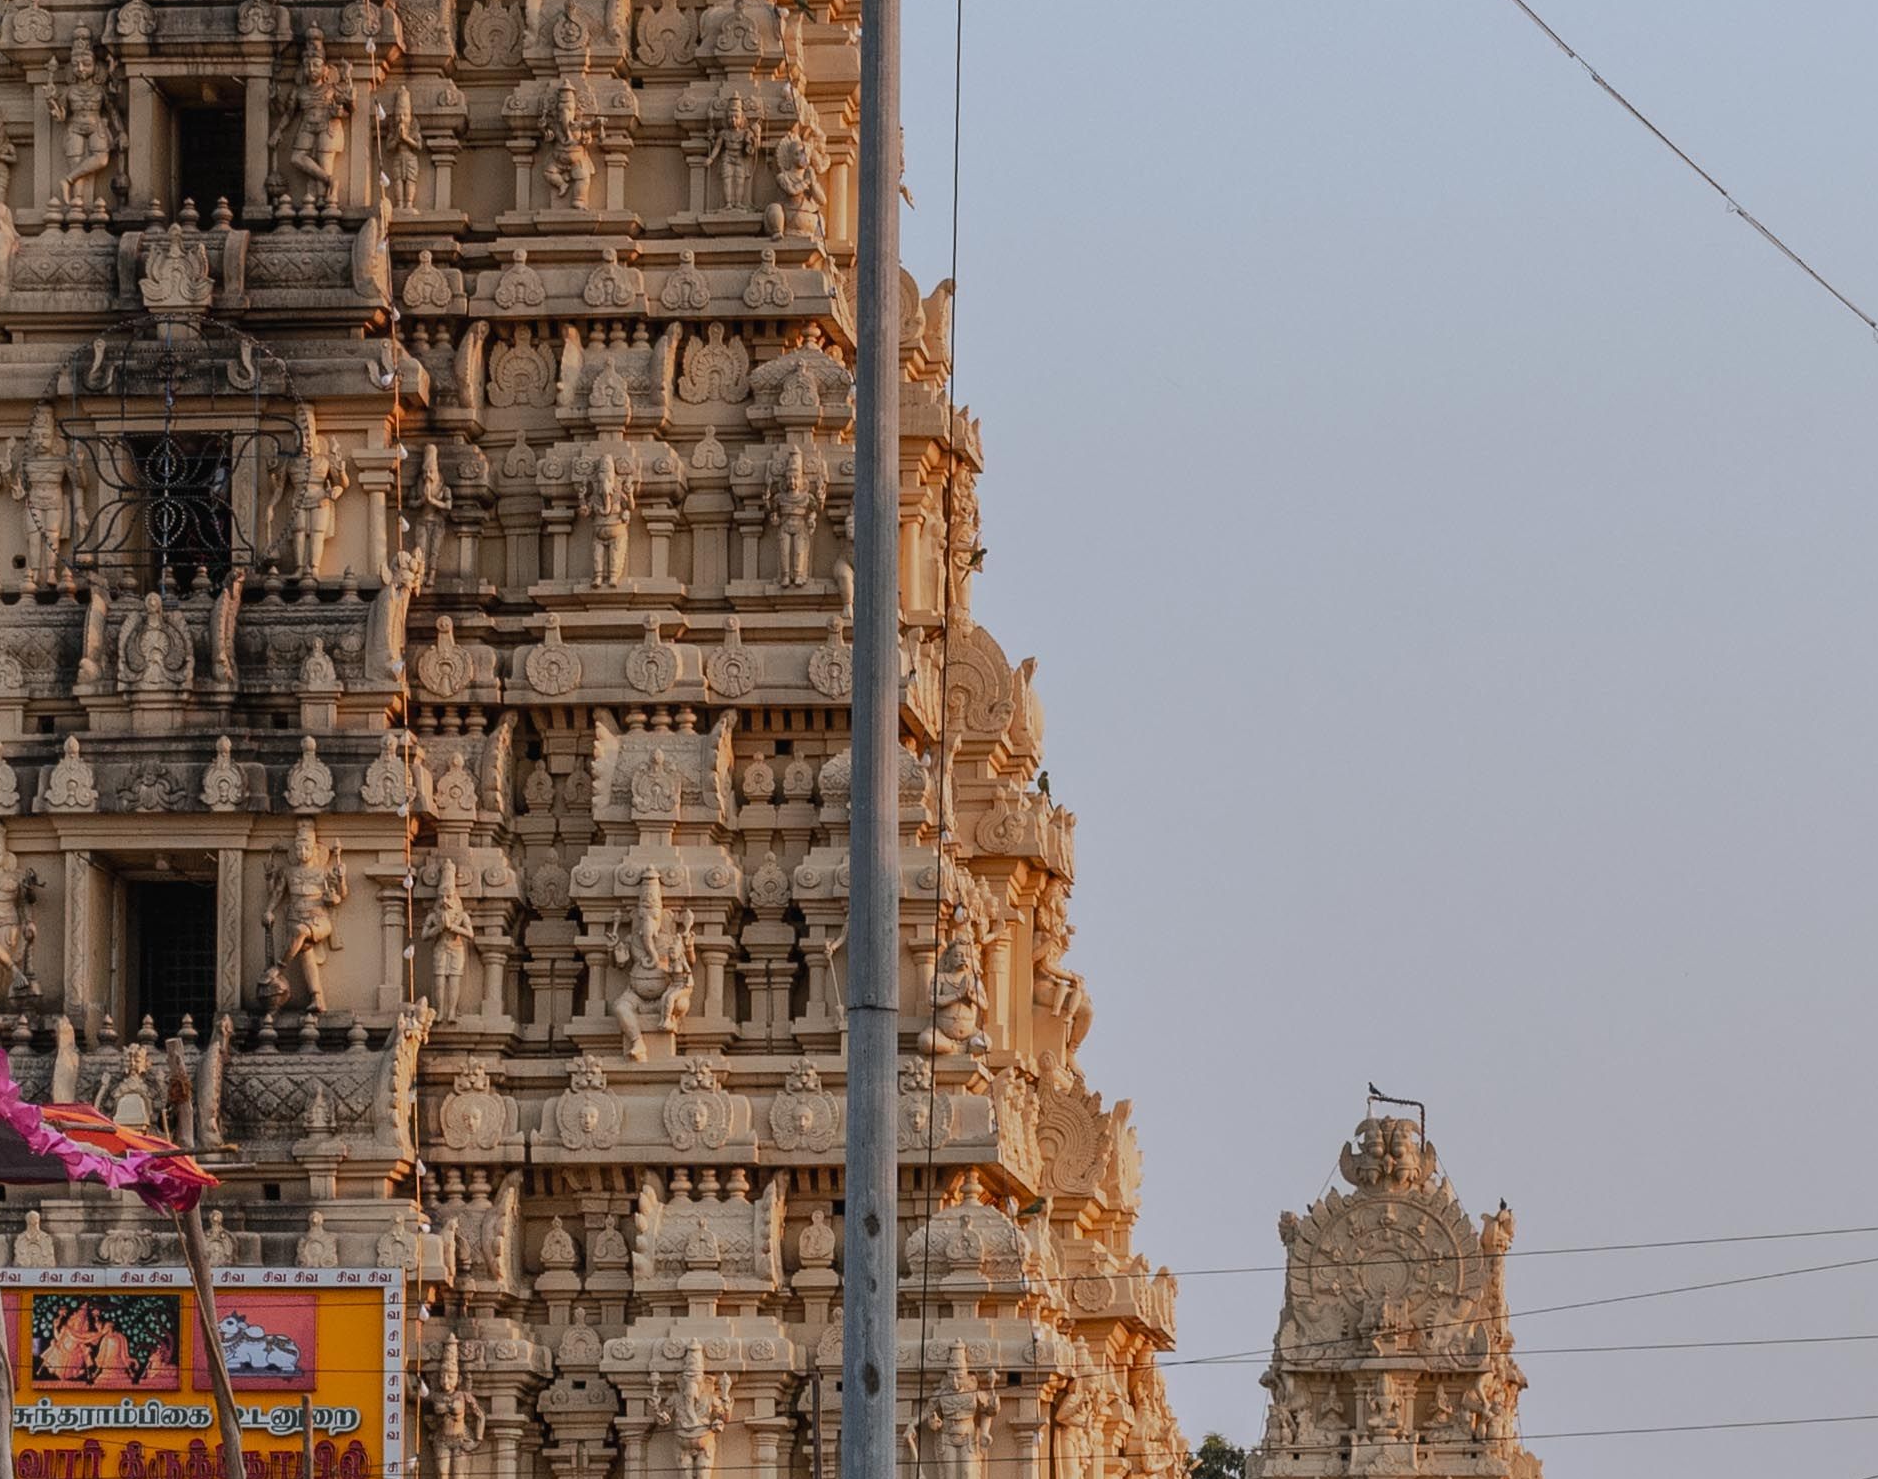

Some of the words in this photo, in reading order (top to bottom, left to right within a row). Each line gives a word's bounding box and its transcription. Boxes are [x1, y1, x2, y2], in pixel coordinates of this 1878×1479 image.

[39, 1270, 62, 1282] சிவ
[70, 1270, 94, 1282] சிவ
[121, 1271, 144, 1283] சிவ
[149, 1271, 173, 1283] சிவ
[221, 1271, 244, 1283] சிவ
[263, 1271, 286, 1283] சிவ
[295, 1271, 318, 1283] சிவ
[336, 1271, 360, 1283] சிவ
[368, 1271, 392, 1283] சிவ
